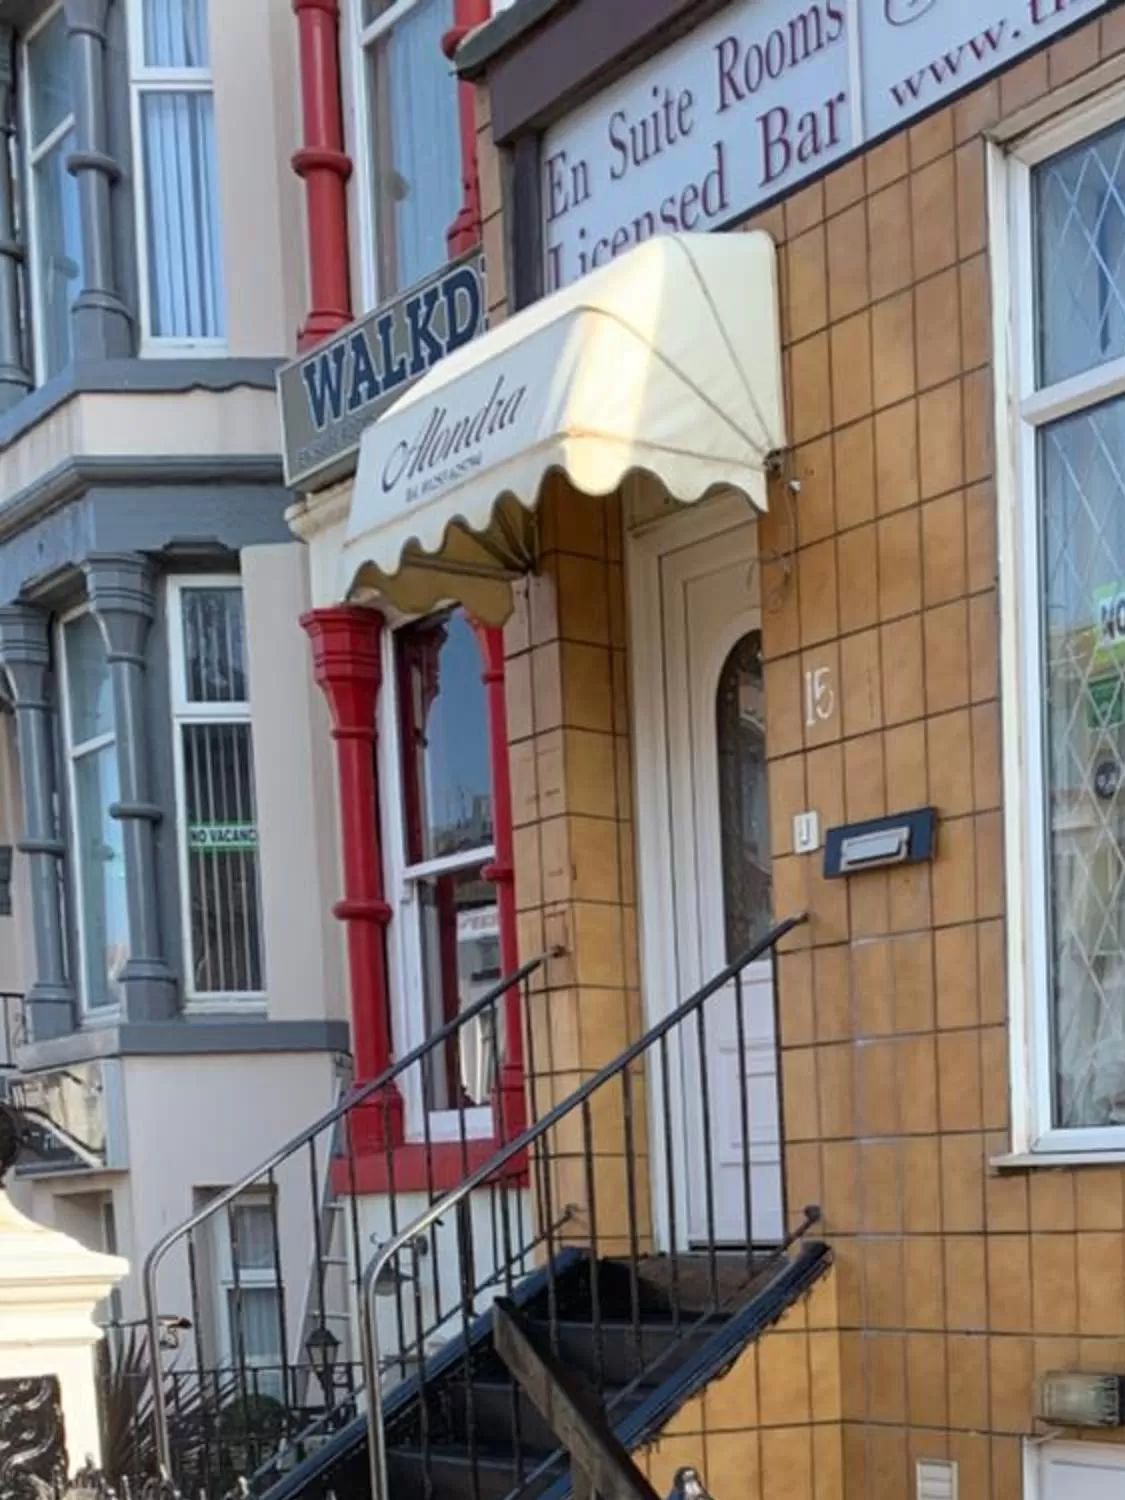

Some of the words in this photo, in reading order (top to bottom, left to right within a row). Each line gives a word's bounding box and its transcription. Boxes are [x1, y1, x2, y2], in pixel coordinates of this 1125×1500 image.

[544, 150, 592, 224] En
[607, 85, 694, 182] Suite
[712, 0, 845, 114] Rooms
[756, 91, 846, 189] Bar
[302, 256, 488, 432] WALKD
[804, 666, 834, 728] 15
